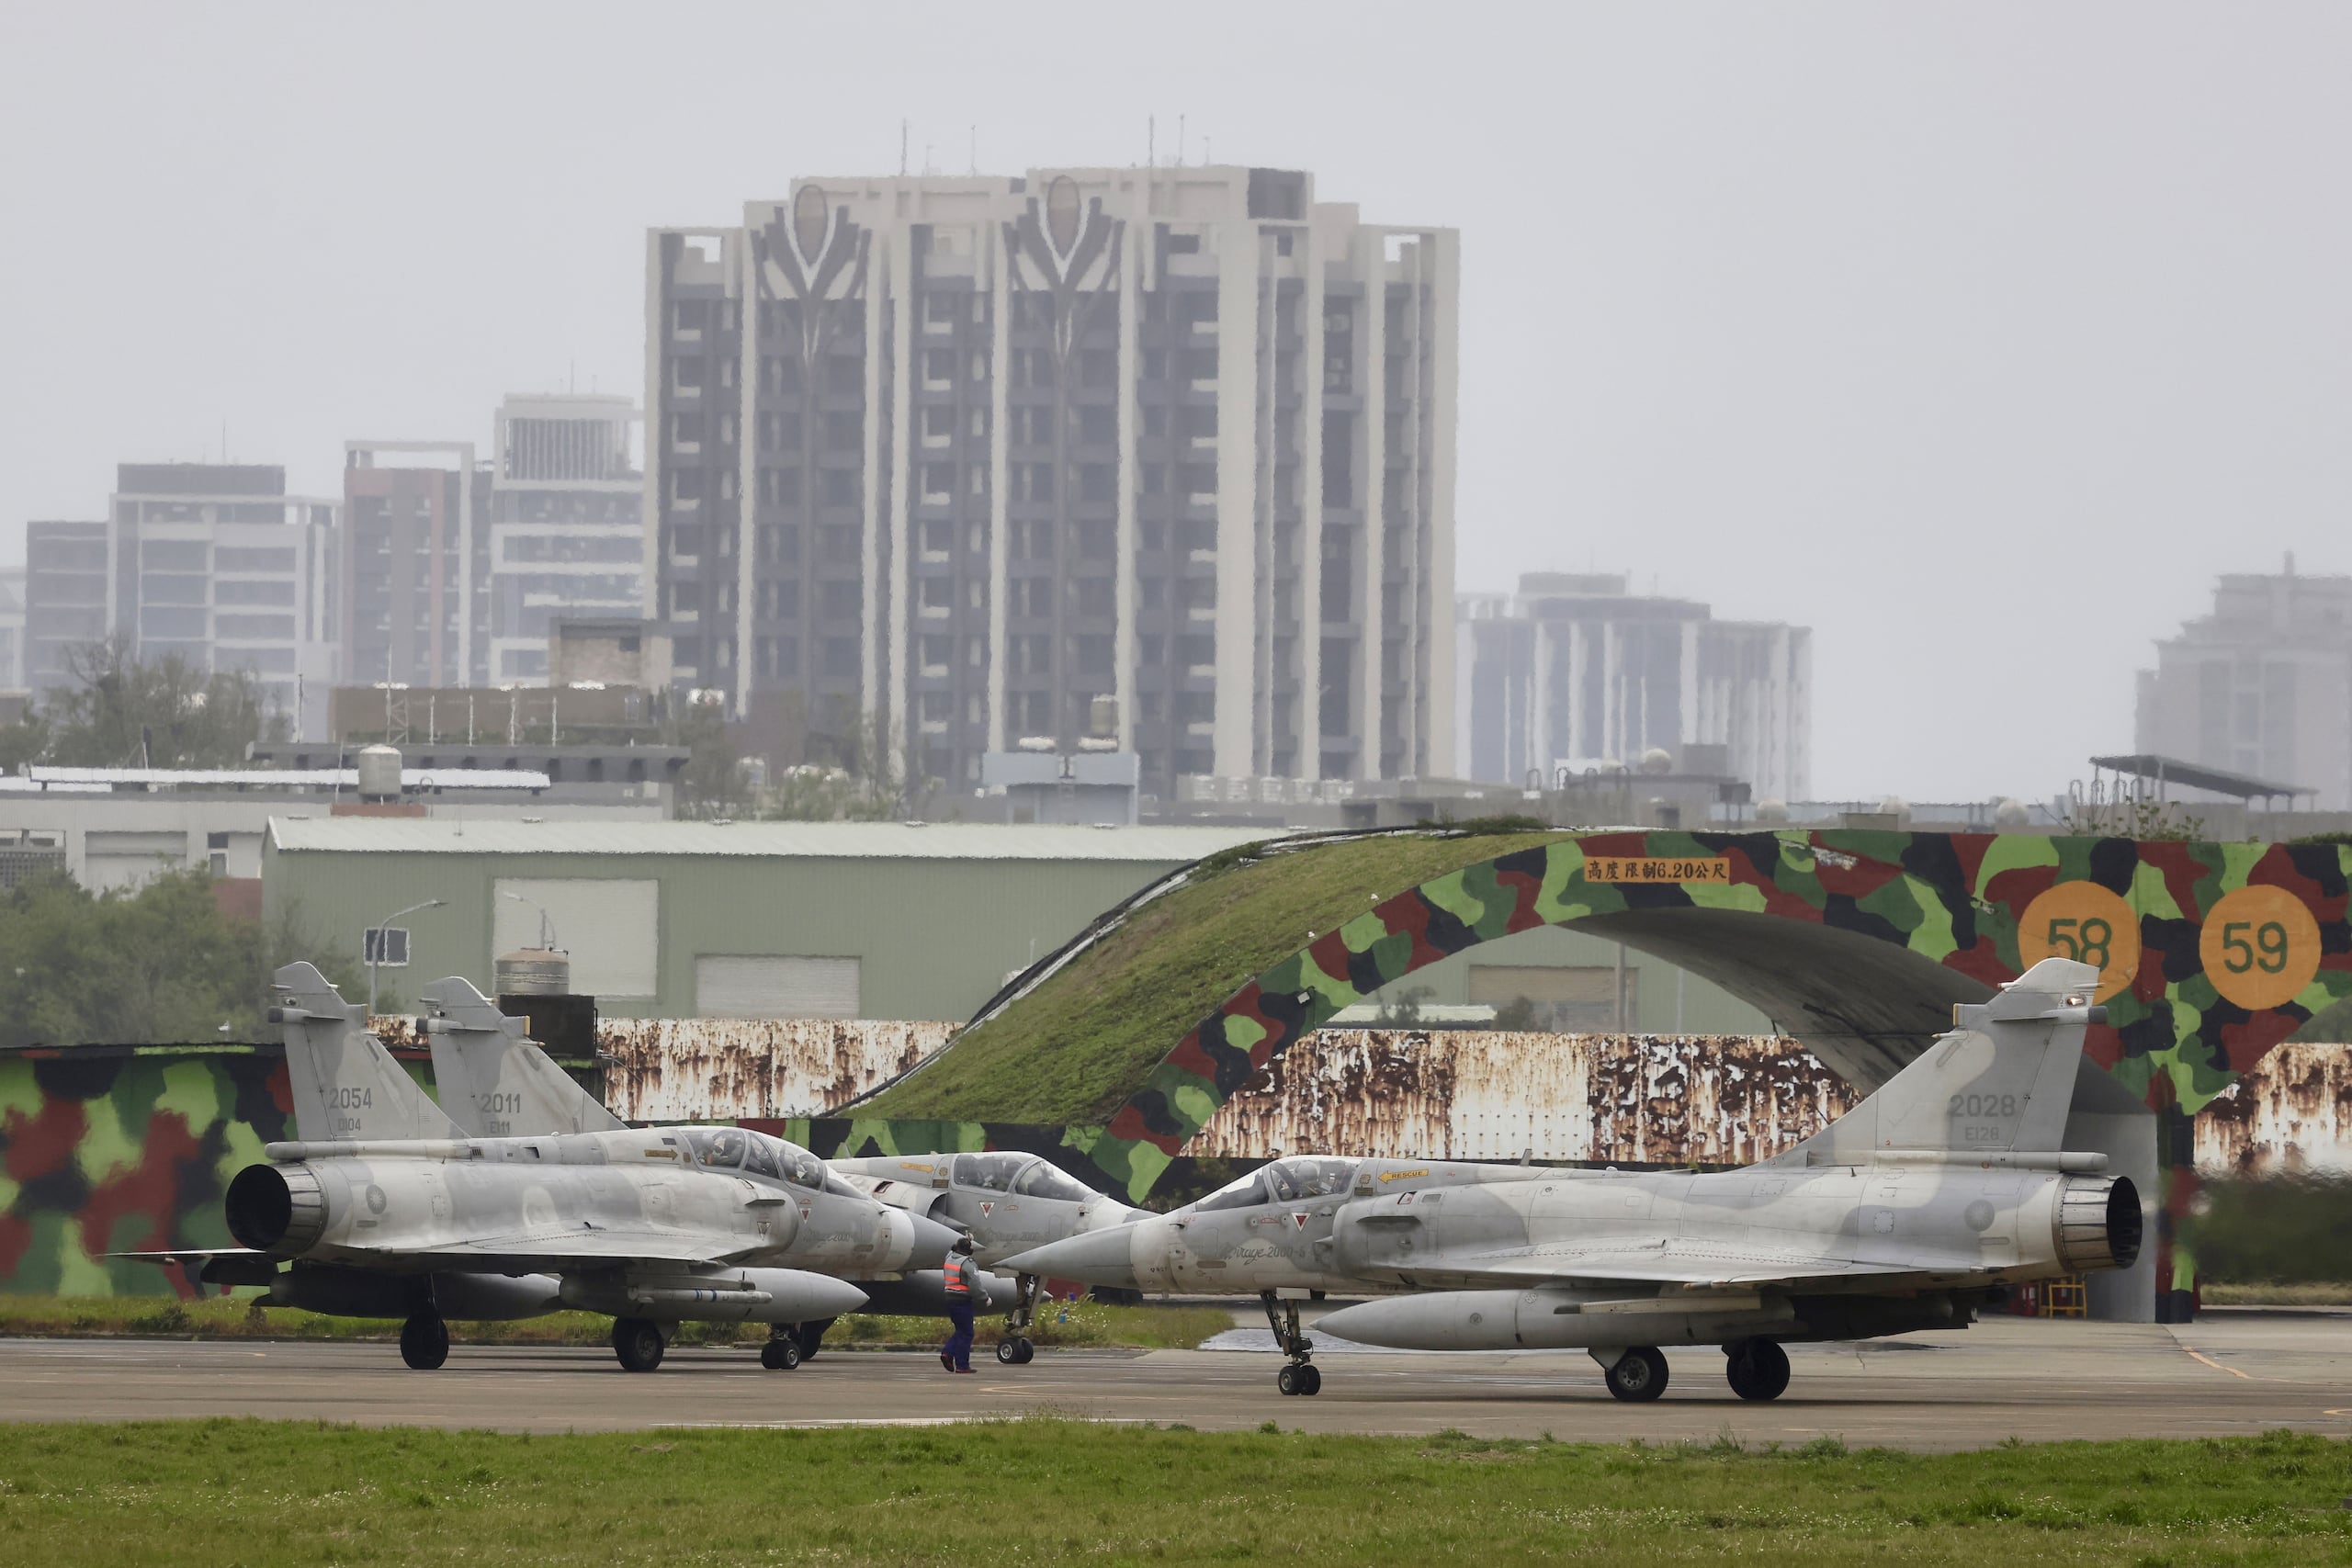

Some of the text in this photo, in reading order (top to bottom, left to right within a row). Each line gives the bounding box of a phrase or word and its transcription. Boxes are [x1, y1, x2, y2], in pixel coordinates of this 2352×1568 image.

[1589, 860, 1726, 880] 高度限制6.20公尺
[2048, 918, 2112, 972] 58
[2222, 921, 2288, 974] 59
[329, 1088, 372, 1109] 2054
[481, 1093, 521, 1113] 2011
[1949, 1094, 2016, 1118] 2028
[1965, 1126, 1999, 1141] E128
[1391, 1170, 1423, 1179] RESCUE
